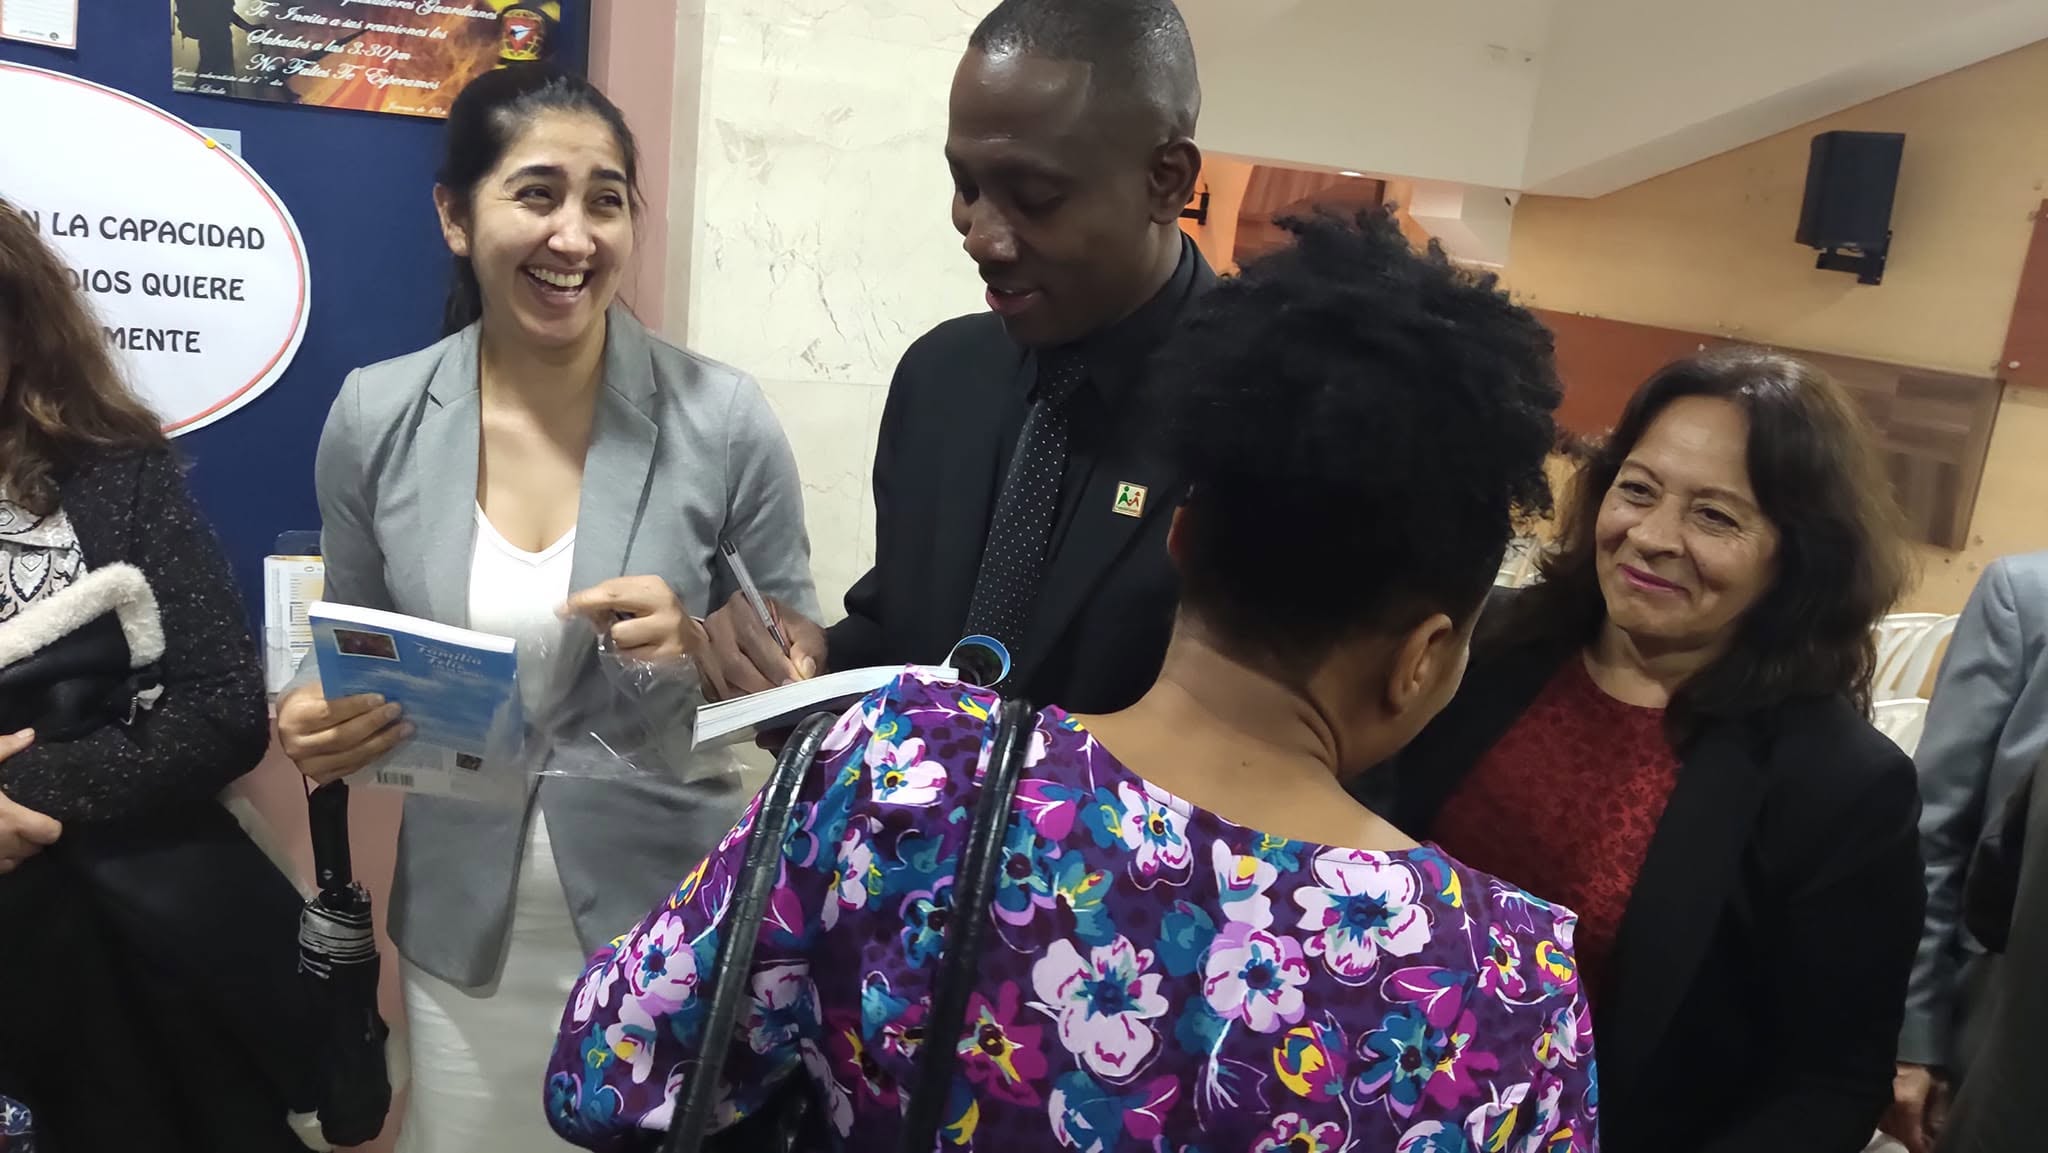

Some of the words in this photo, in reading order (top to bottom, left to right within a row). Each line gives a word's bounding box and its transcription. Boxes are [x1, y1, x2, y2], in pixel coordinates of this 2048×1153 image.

[245, 1, 280, 17] Te
[275, 6, 328, 25] Invita
[329, 18, 341, 27] a
[364, 22, 429, 37] reuniones
[429, 26, 448, 39] los
[416, 0, 497, 20] Guardianes
[246, 29, 311, 49] Sabados
[311, 42, 323, 51] a
[324, 40, 345, 53] las
[245, 53, 286, 72] No
[282, 58, 330, 78] Faltes
[332, 63, 367, 80] Te
[364, 67, 441, 90] Esperamos
[52, 212, 90, 237] LA
[99, 215, 265, 250] CAPACIDAD
[142, 272, 246, 301] QUIERE
